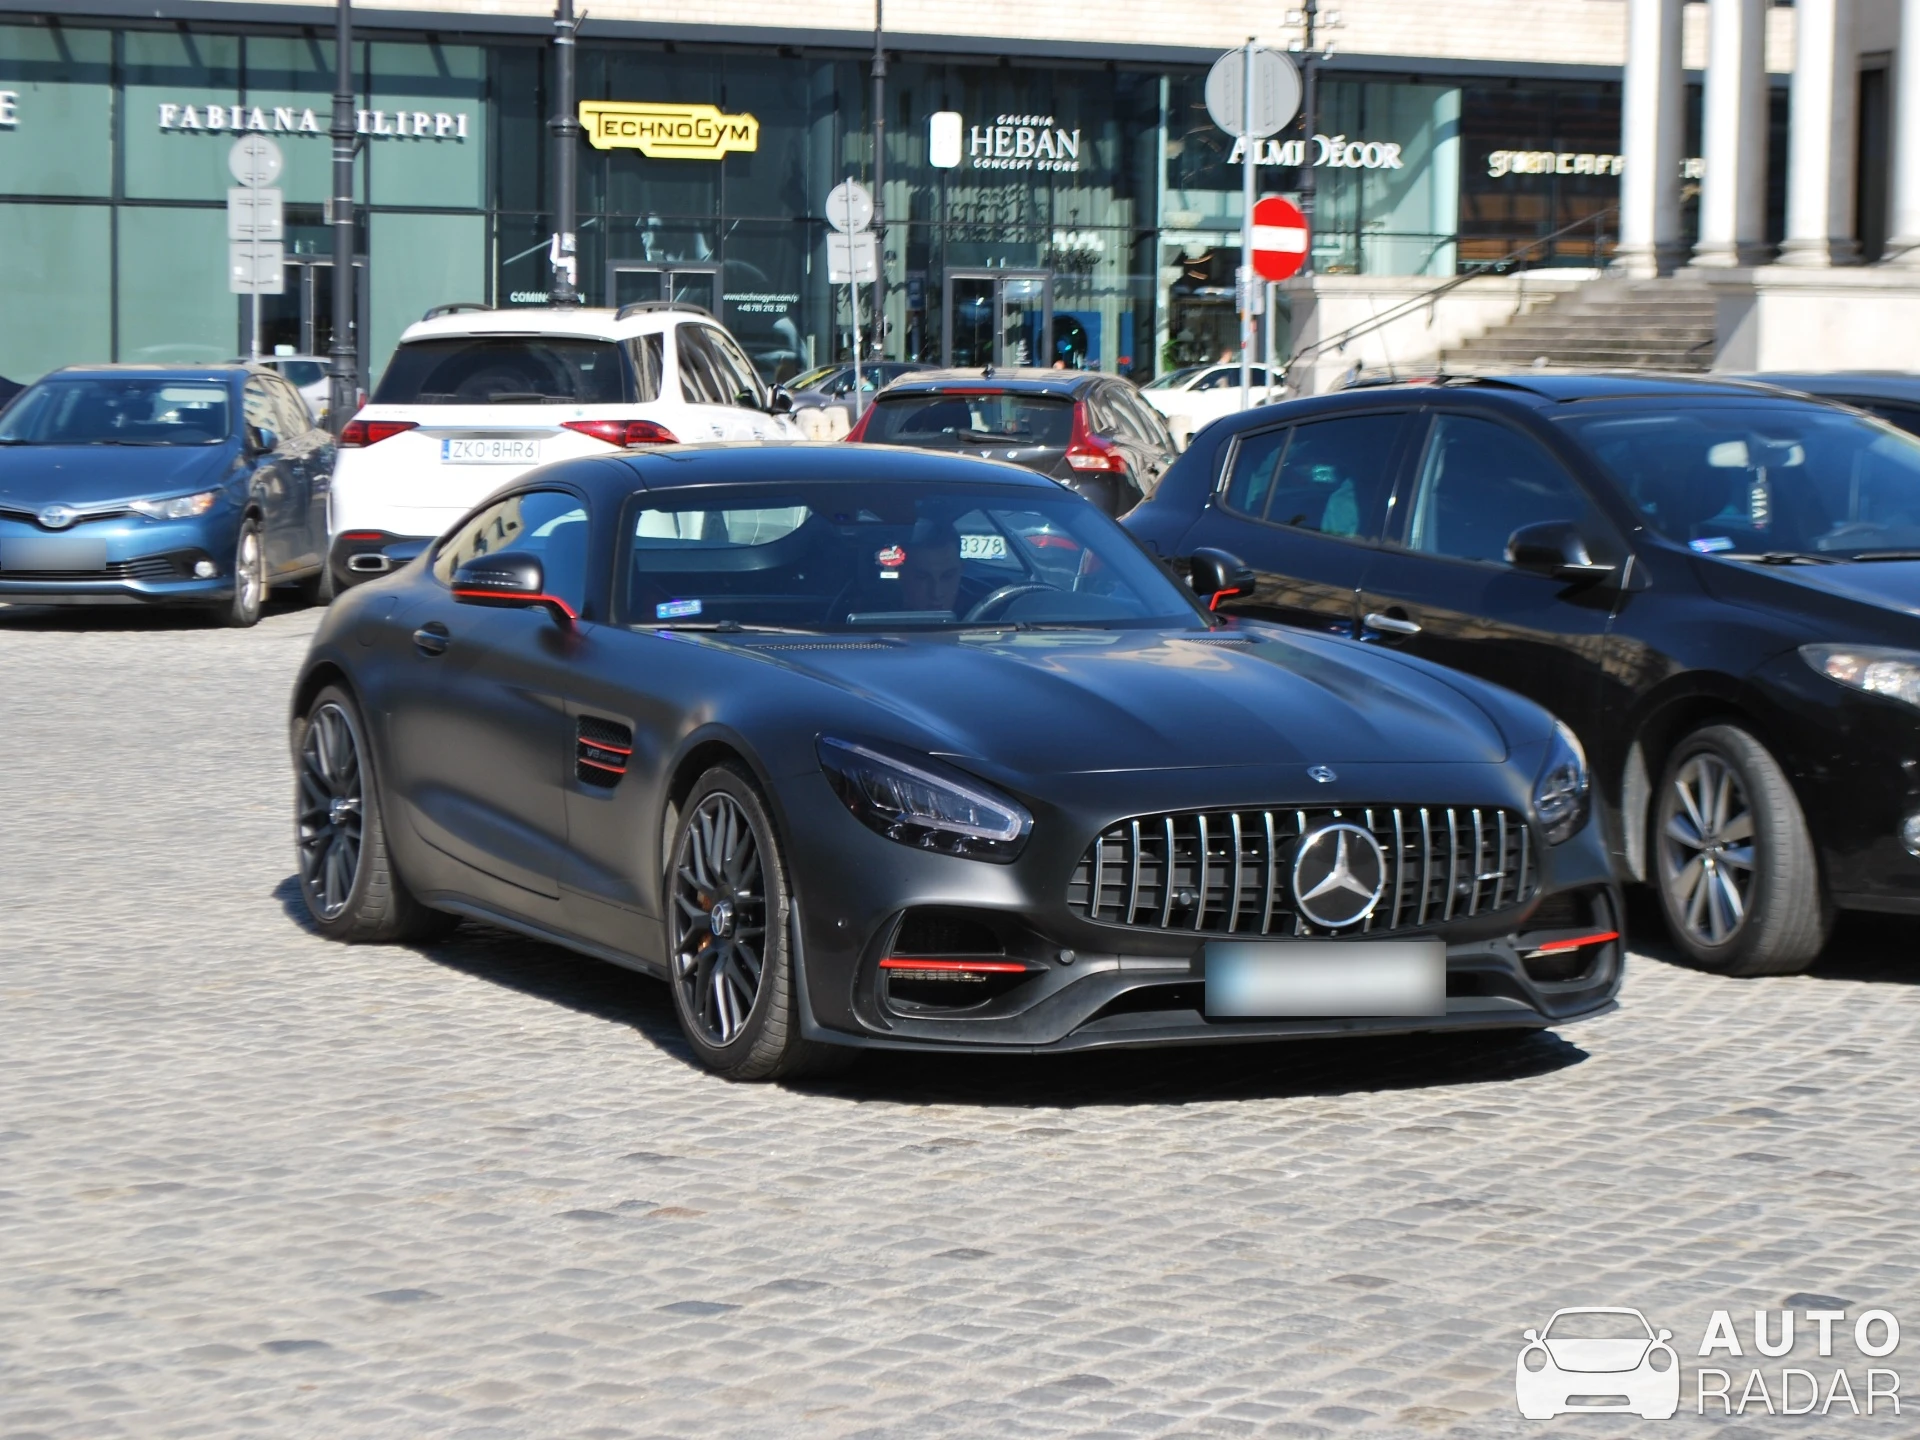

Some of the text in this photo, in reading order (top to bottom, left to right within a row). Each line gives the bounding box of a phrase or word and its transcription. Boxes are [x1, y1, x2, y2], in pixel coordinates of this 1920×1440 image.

[159, 104, 467, 138] FABIANA ILIPPI
[997, 114, 1054, 126] GALERIA
[970, 125, 1081, 159] HEBAN
[973, 158, 1080, 172] CONCEPT STORE
[453, 441, 534, 458] ZKO 8HR6
